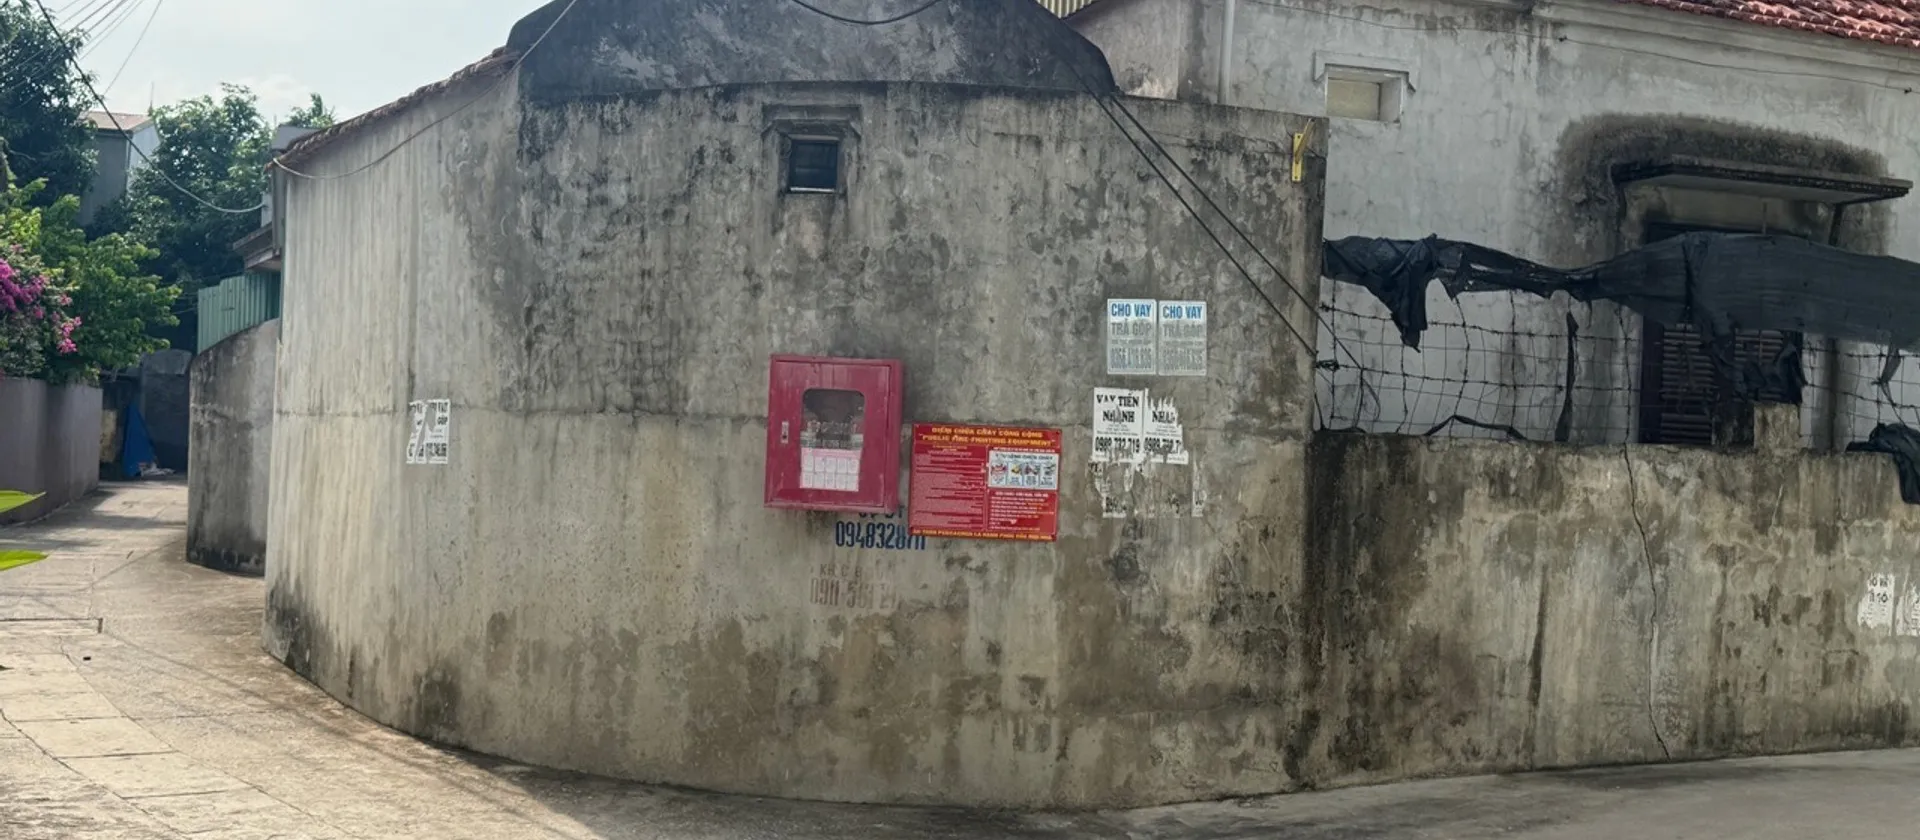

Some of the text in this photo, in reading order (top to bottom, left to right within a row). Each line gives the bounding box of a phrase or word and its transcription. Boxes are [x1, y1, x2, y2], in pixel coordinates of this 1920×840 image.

[1111, 303, 1152, 317] CHO VAY
[1163, 305, 1203, 319] CHO VAY
